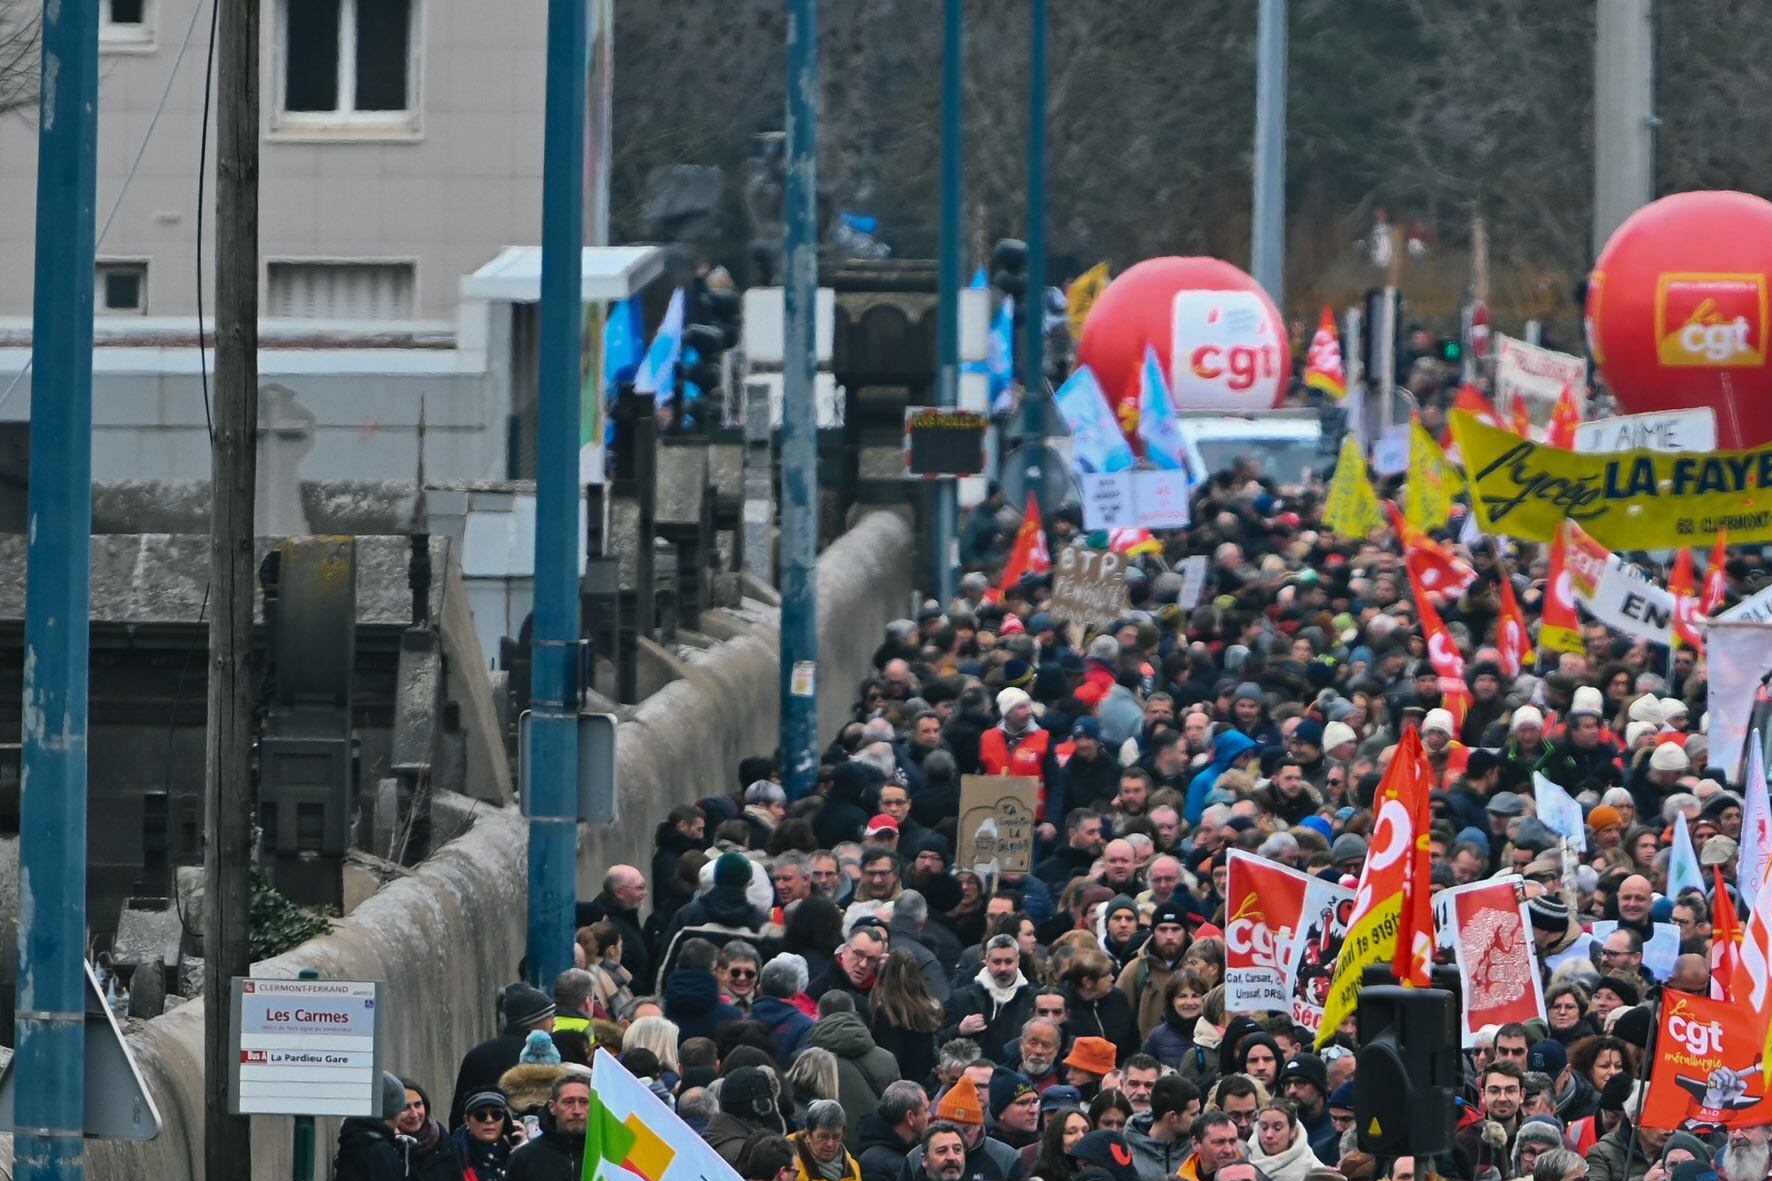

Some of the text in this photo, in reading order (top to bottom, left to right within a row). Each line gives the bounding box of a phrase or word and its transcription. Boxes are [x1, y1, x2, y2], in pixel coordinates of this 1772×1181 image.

[1681, 315, 1750, 361] cgt
[1604, 457, 1658, 498] LA
[1226, 918, 1295, 984] cgt
[259, 984, 349, 993] CLERMONT-FERRAND
[266, 1008, 349, 1023] Les Carmes
[1668, 1015, 1724, 1055] cgt
[271, 1053, 348, 1063] La Pardieu Gare
[1664, 1052, 1722, 1073] métallurgie
